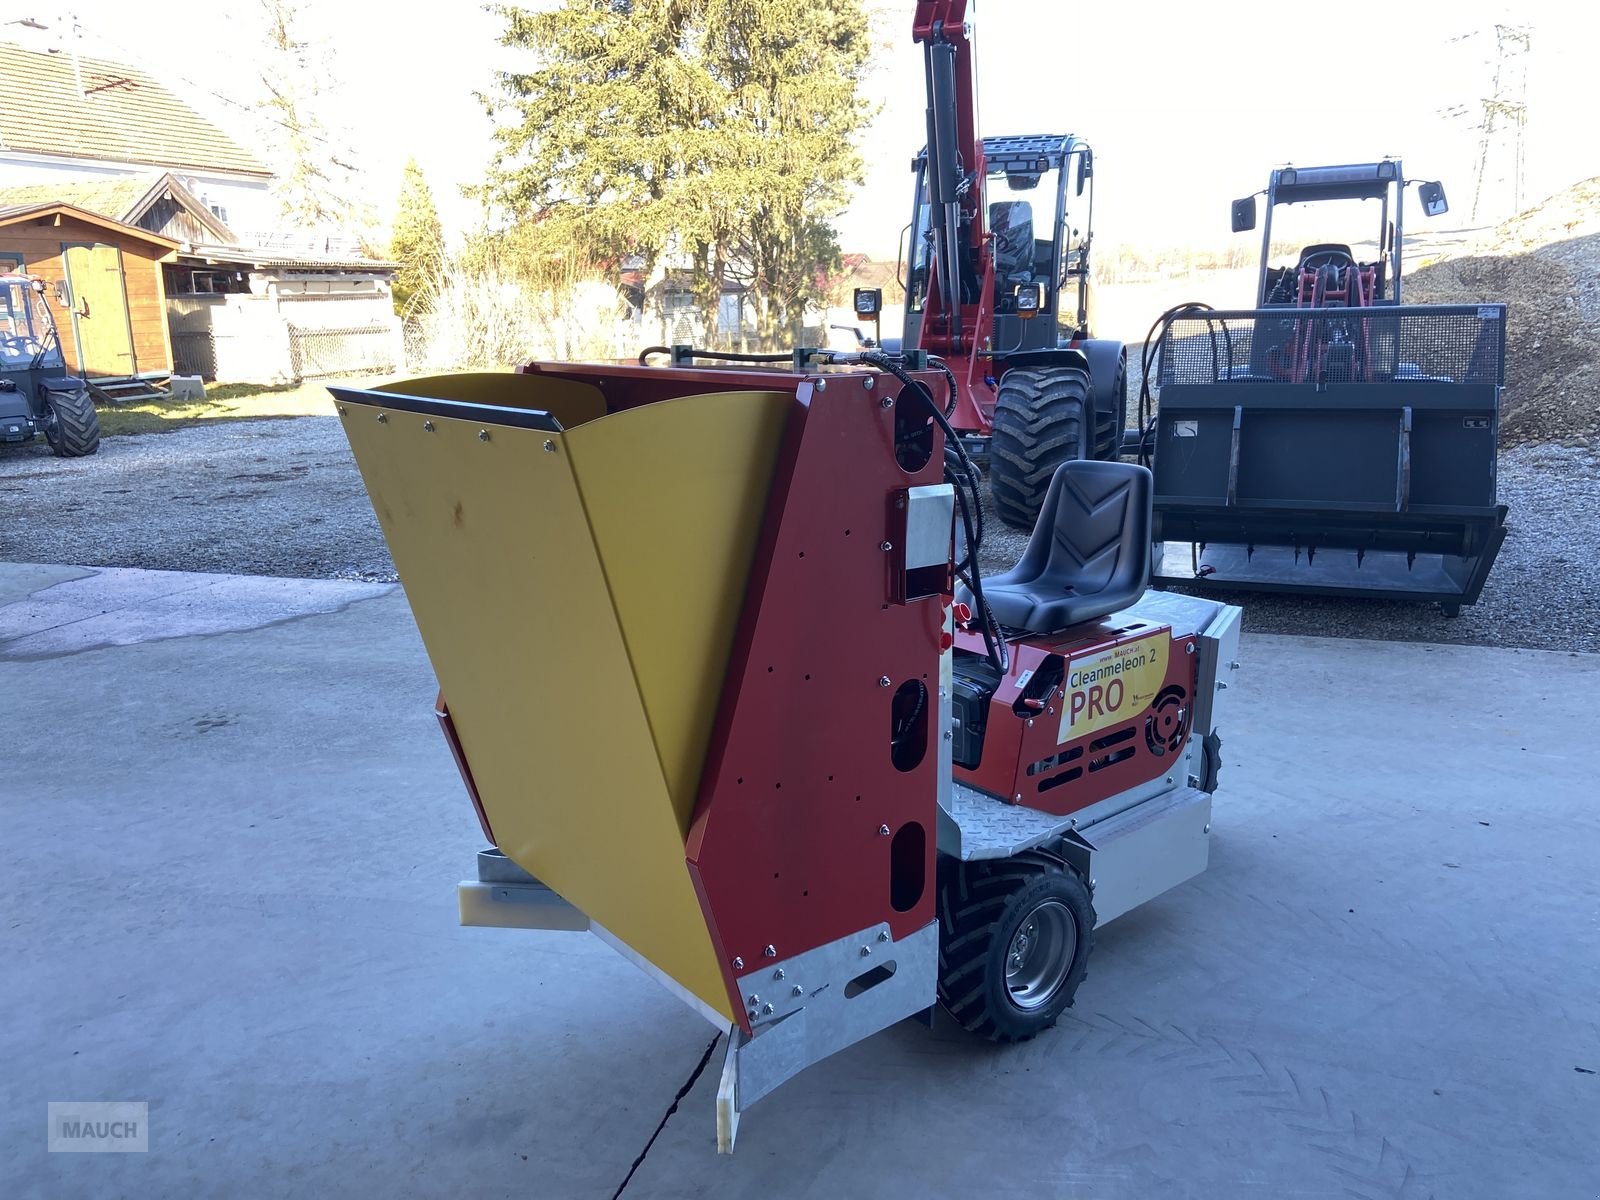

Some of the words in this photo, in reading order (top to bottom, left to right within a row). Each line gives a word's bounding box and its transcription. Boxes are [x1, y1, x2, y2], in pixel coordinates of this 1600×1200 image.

[1070, 655, 1145, 688] Cleanmeleon
[1149, 648, 1157, 663] 2
[1070, 678, 1124, 726] PRO
